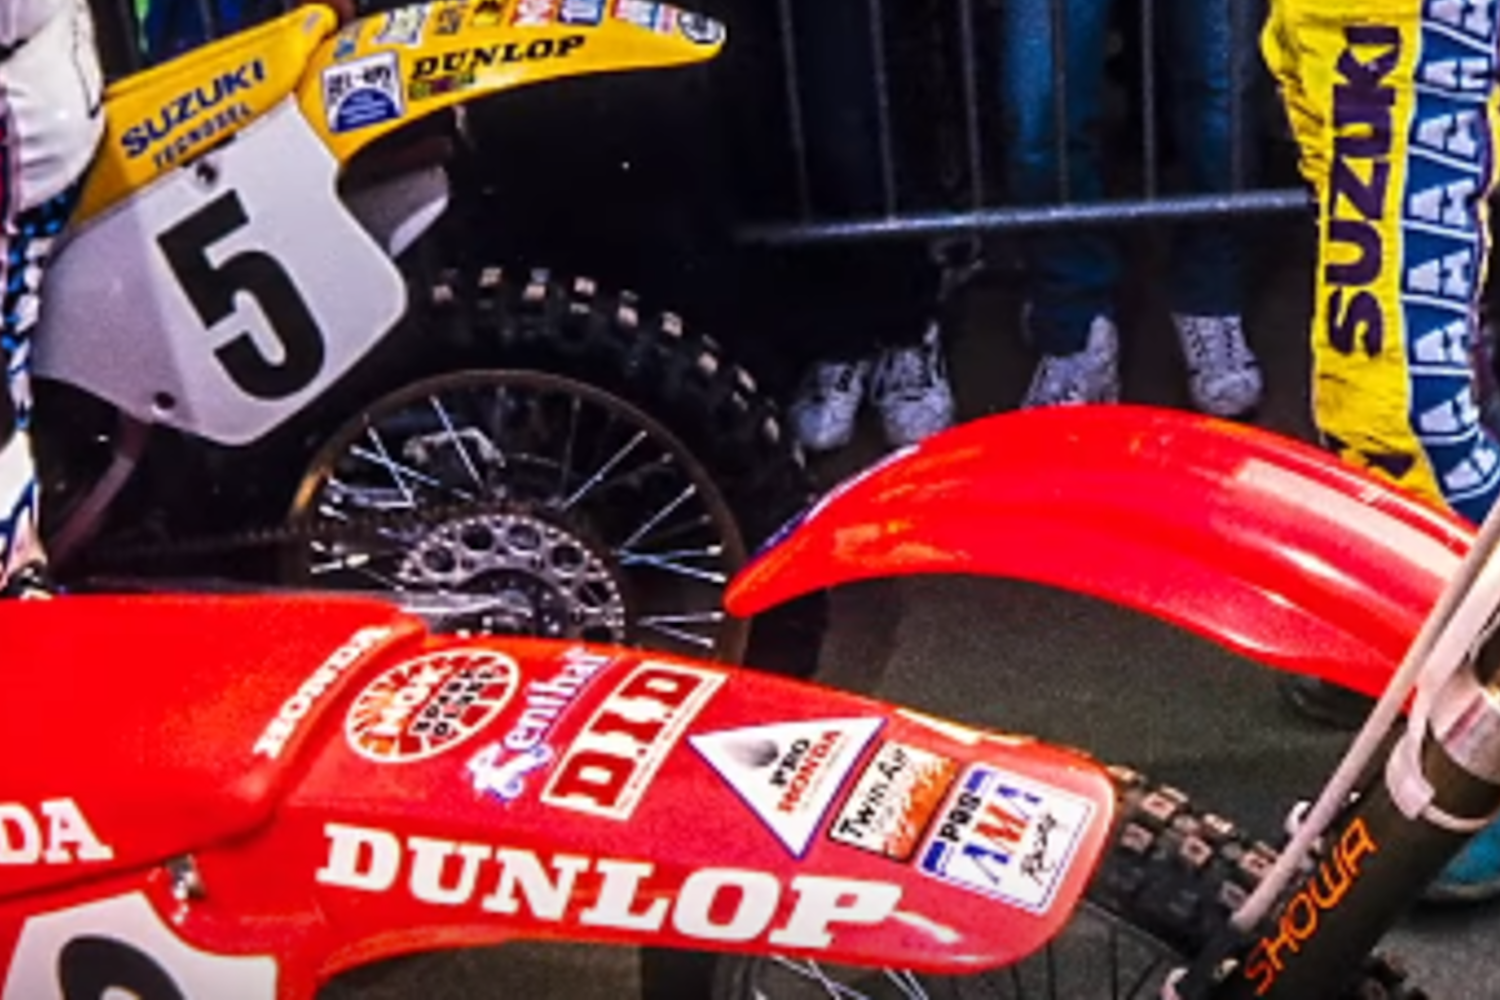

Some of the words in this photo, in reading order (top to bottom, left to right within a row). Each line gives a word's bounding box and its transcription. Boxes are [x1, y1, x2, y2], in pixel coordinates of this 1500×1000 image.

[119, 57, 268, 161] SUZUKI
[411, 33, 587, 82] DUNLOP
[1324, 24, 1402, 358] SUZUKI
[155, 188, 328, 401] 5
[252, 626, 392, 760] HONDA
[464, 645, 607, 803] Renthal
[772, 736, 811, 788] PRO
[775, 730, 843, 815] HONDA
[316, 822, 904, 949] DUNLOP
[1243, 812, 1380, 998] SHOWA
